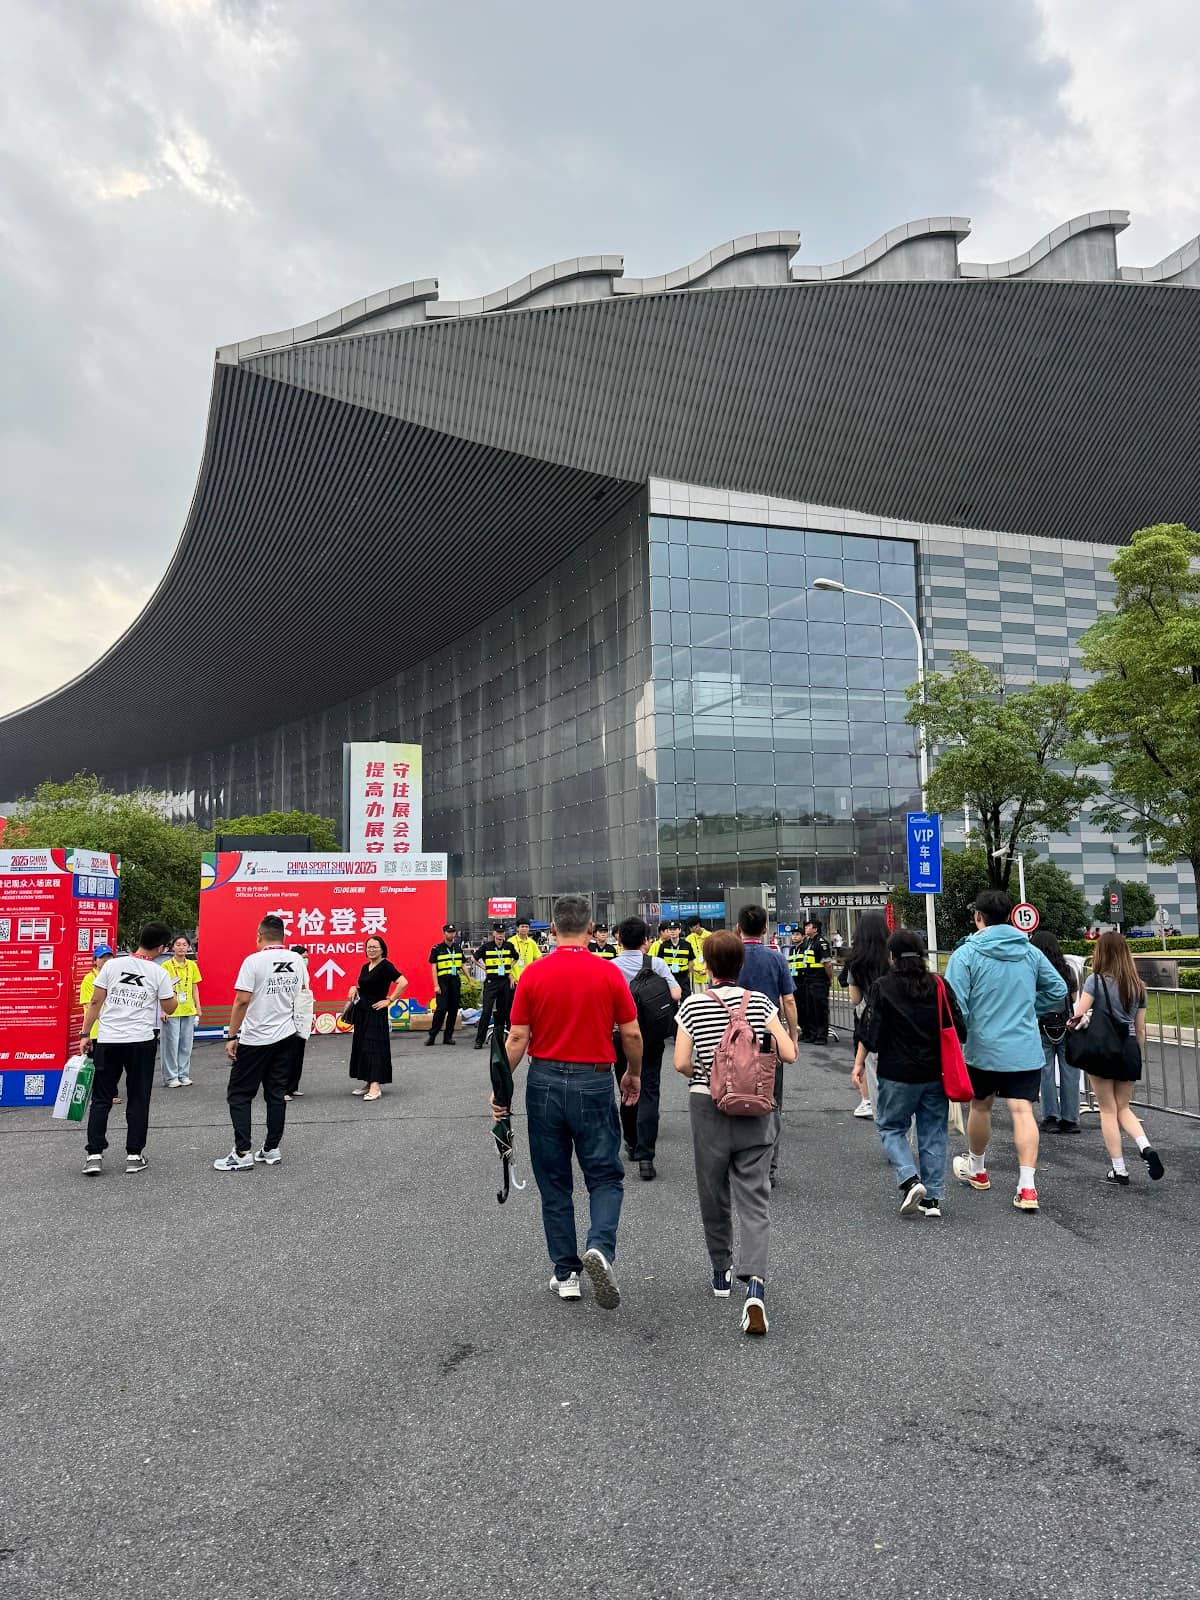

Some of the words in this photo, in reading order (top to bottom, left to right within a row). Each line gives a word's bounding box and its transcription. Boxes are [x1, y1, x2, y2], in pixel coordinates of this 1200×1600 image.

[913, 829, 934, 842] VIP
[919, 845, 931, 875] 车道
[288, 861, 308, 870] CHINA
[309, 861, 332, 870] SPORT
[332, 861, 354, 874] SHOW
[354, 861, 377, 874] 2025
[1018, 910, 1031, 921] 15
[272, 961, 295, 973] ZK
[119, 971, 146, 987] ZK
